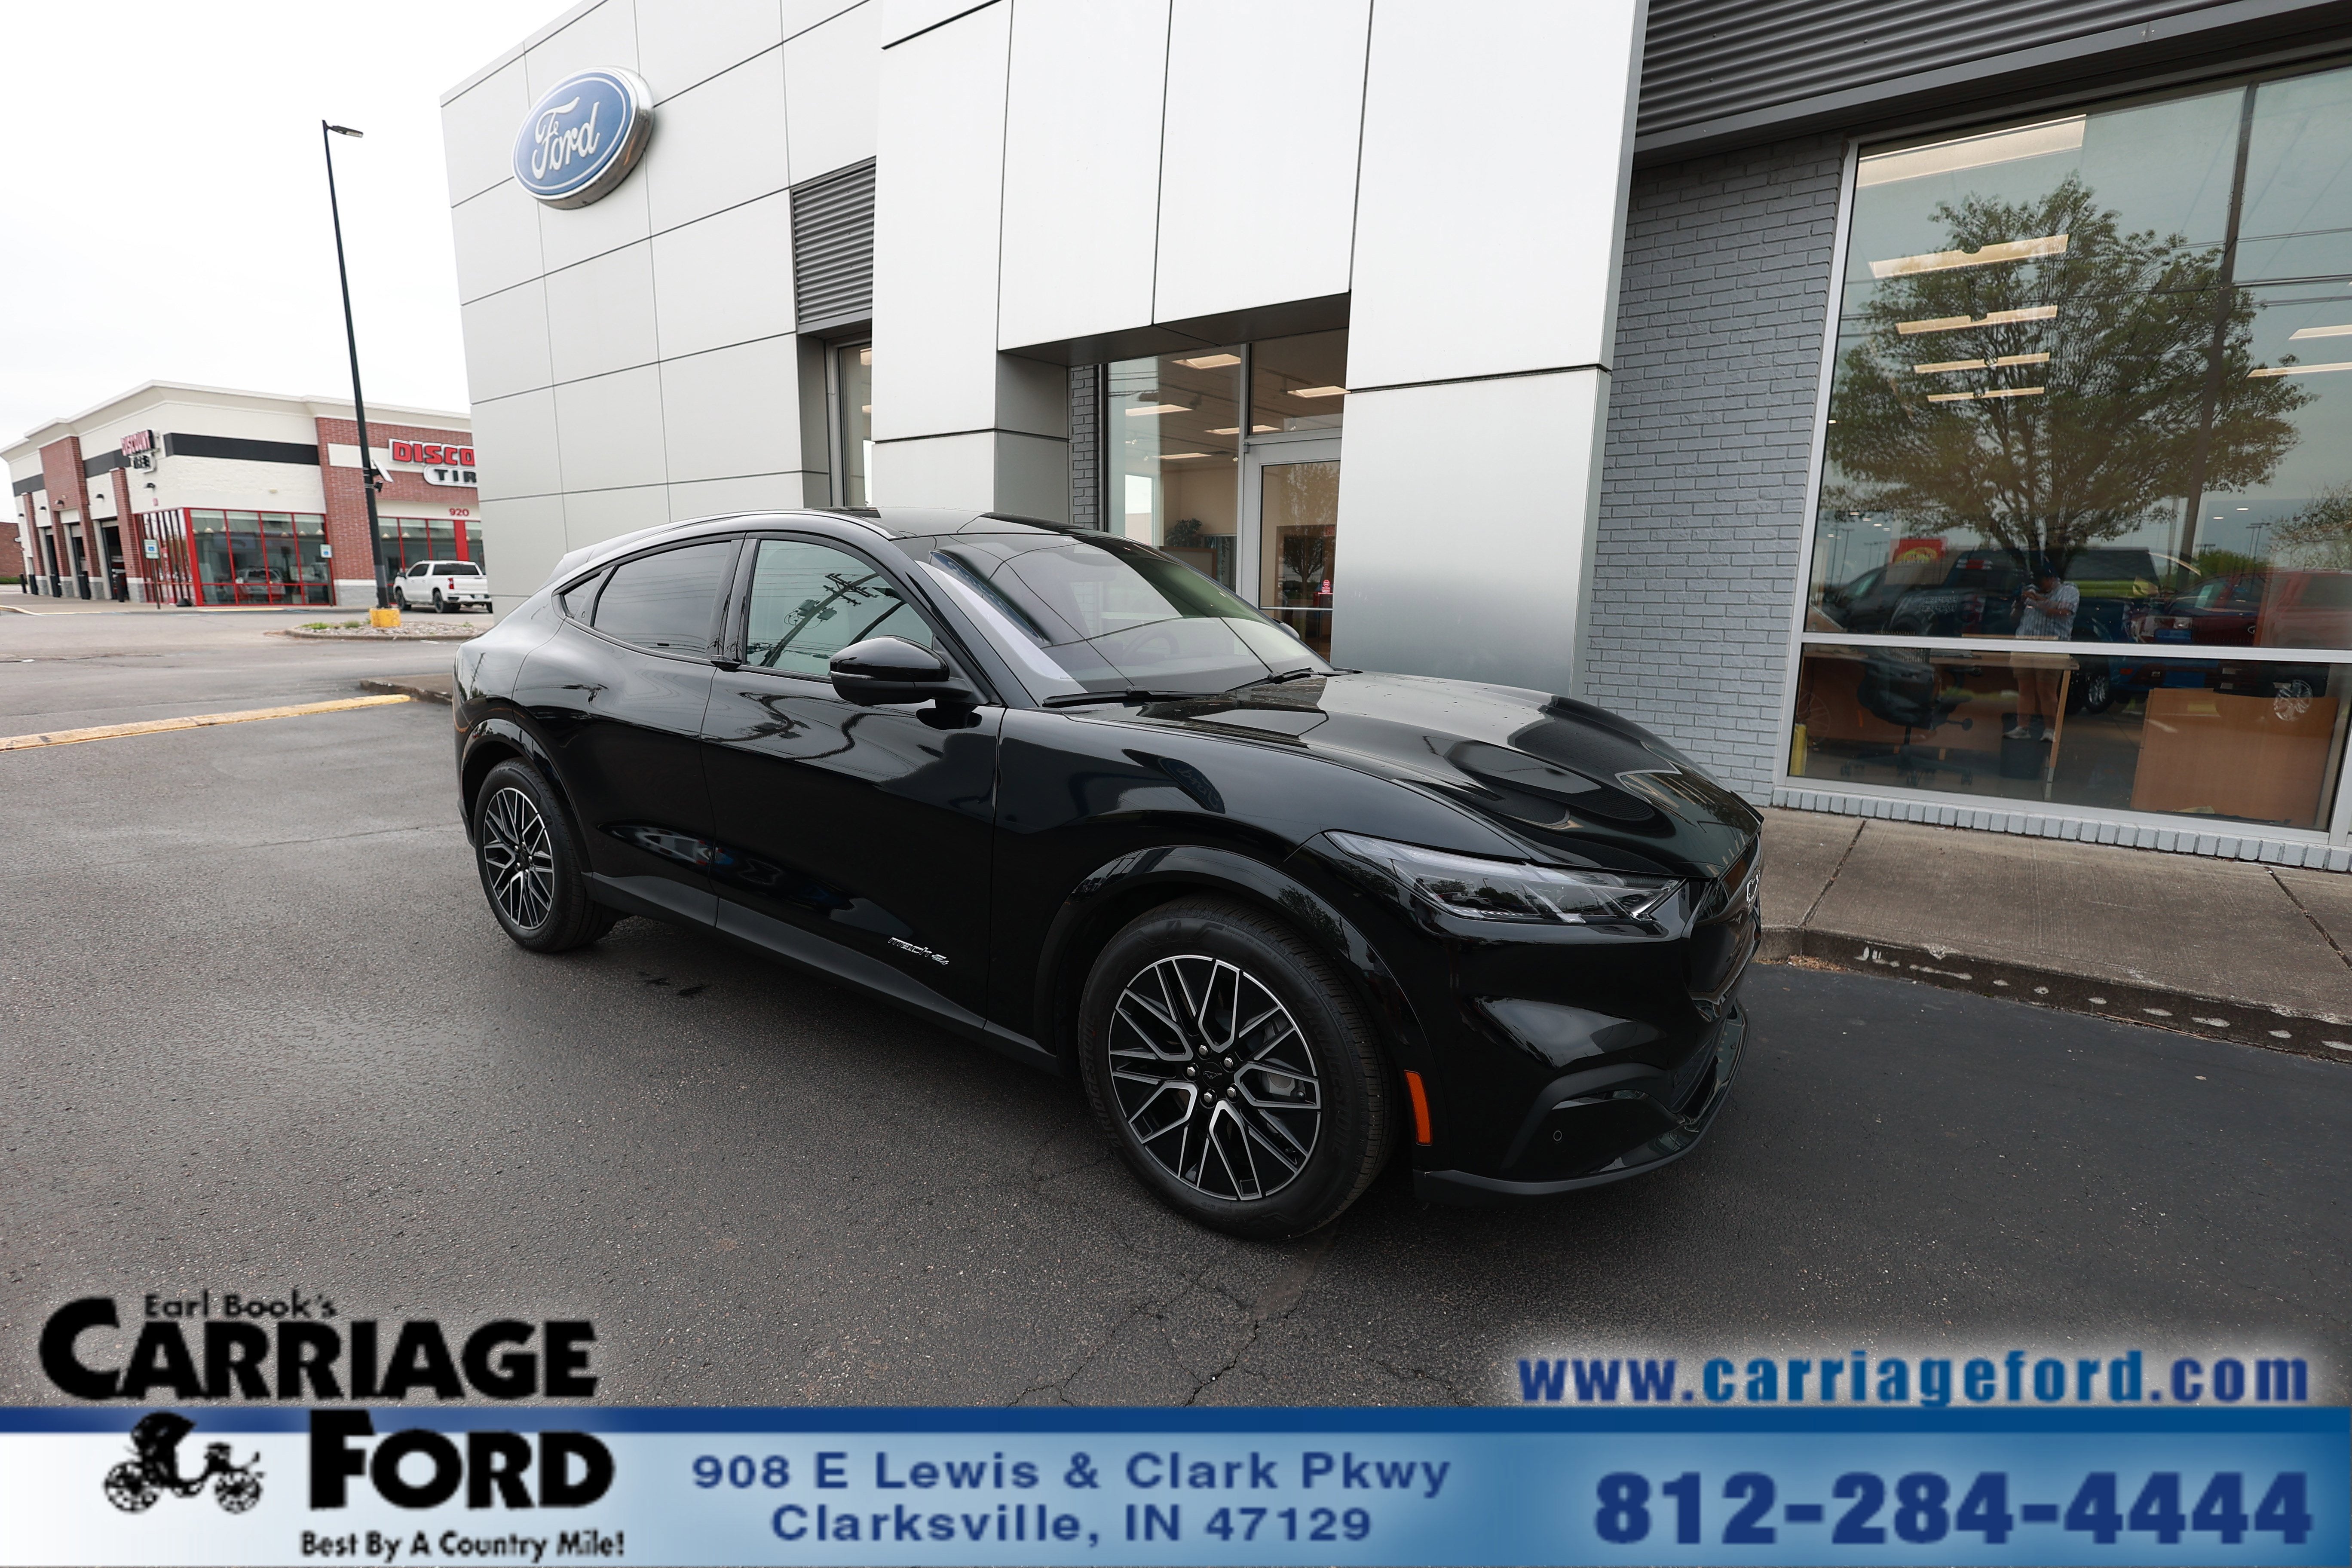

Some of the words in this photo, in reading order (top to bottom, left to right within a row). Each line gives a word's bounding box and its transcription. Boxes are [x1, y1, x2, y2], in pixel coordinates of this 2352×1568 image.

[531, 96, 600, 180] Ford
[449, 508, 469, 516] 920
[1296, 996, 1352, 1156] BRIDGESTONE
